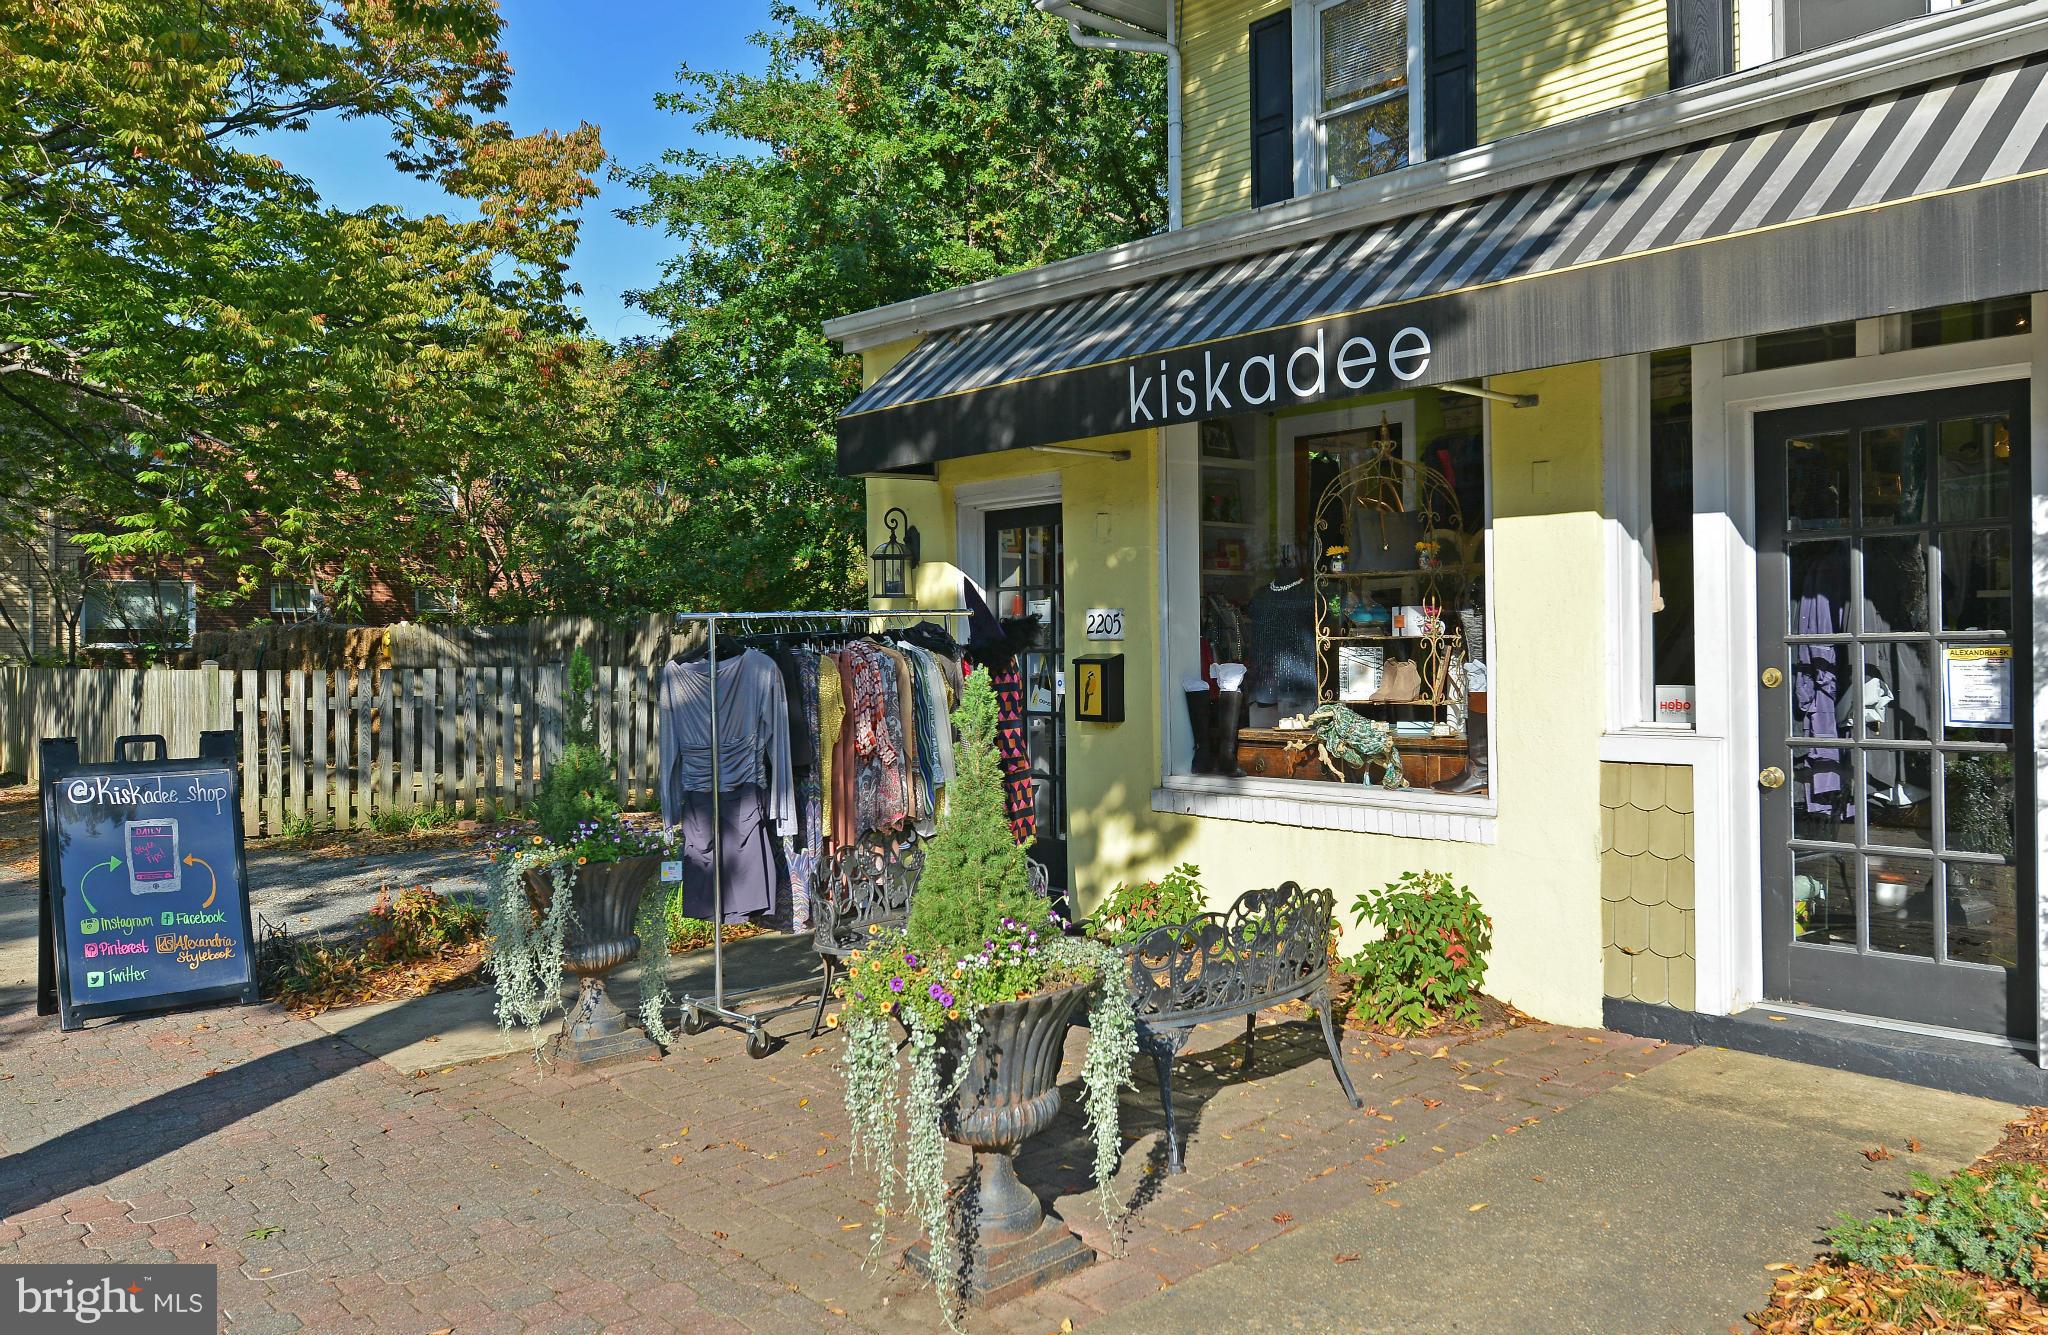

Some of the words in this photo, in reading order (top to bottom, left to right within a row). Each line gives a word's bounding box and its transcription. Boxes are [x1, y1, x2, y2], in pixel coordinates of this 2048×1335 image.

[1129, 326, 1432, 424] kiskadee
[1087, 612, 1122, 635] 2205
[135, 827, 161, 835] DAILY
[100, 915, 154, 935] Instagram
[175, 909, 227, 924] Facebook
[99, 939, 149, 956] Pinterest
[175, 933, 237, 951] Alexandria
[106, 965, 149, 985] Twitter
